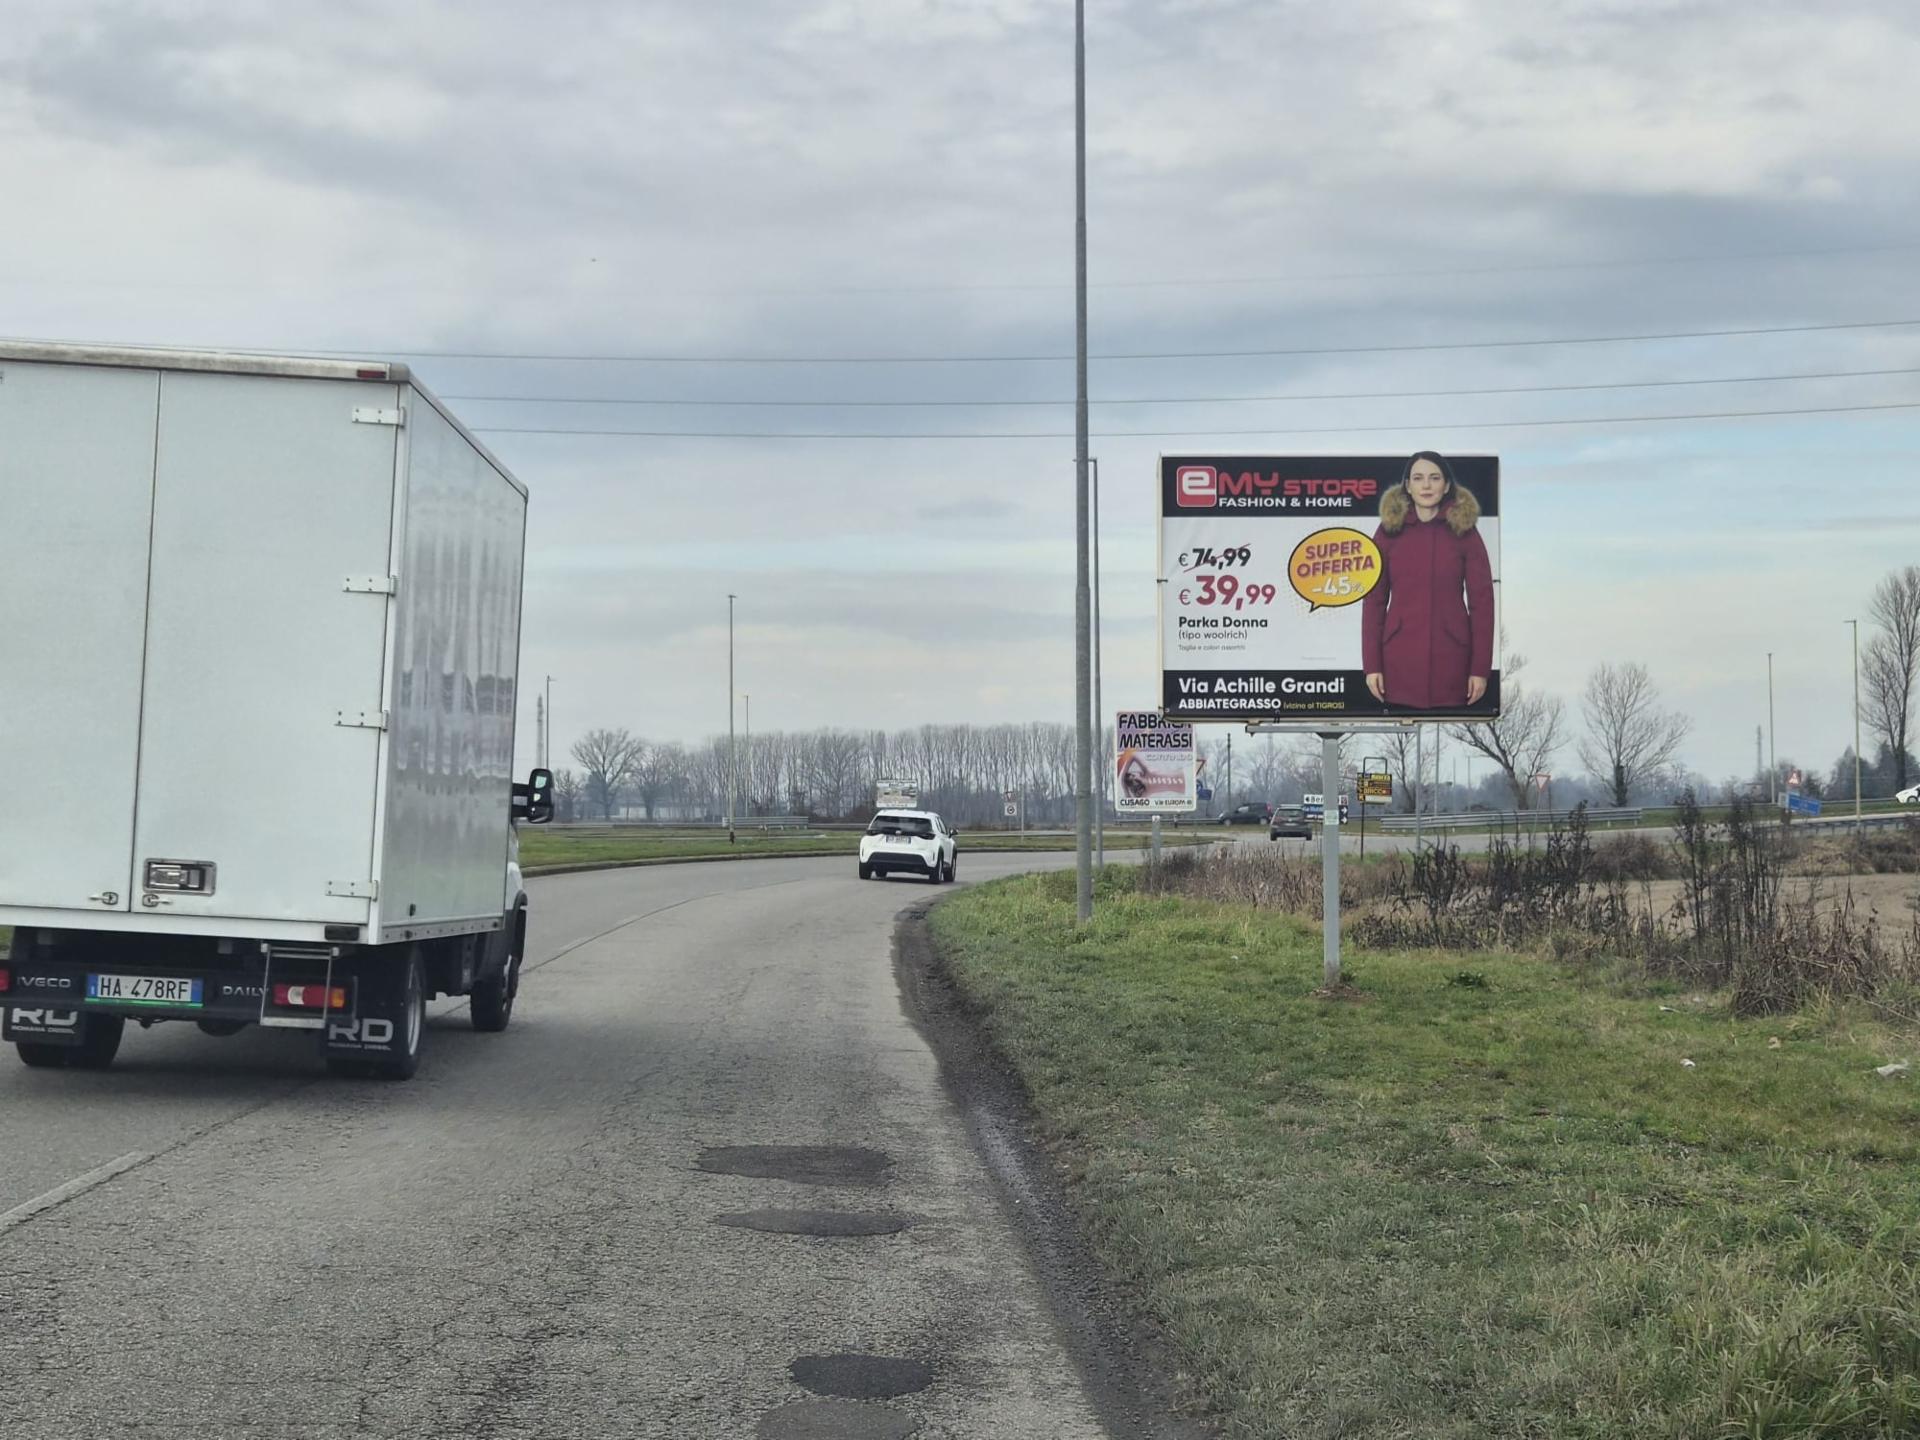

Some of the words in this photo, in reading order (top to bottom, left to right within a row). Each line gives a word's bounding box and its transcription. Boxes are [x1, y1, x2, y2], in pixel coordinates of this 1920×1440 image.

[1219, 472, 1279, 496] MY
[1219, 497, 1286, 508] FASHION
[1290, 497, 1301, 508] &
[1305, 497, 1352, 507] HOME
[1192, 547, 1251, 570] 74,99
[1305, 540, 1362, 560] SUPER
[1296, 555, 1375, 578] OFFERTA
[1195, 575, 1276, 611] 39,99
[1178, 616, 1219, 628] Parka
[1222, 616, 1268, 628] Donna
[1178, 630, 1201, 640] (tipo
[1204, 630, 1248, 640] woolrich)
[1178, 678, 1209, 693] Via
[1214, 677, 1276, 693] Achille
[1281, 677, 1345, 693] Grandi
[1178, 698, 1282, 709] ABBIATEGRASSO
[1119, 733, 1192, 748] MATERASSI
[17, 976, 71, 988] IVECO
[100, 978, 122, 998] HA
[131, 979, 190, 1000] 478RF
[328, 1018, 394, 1043] RD
